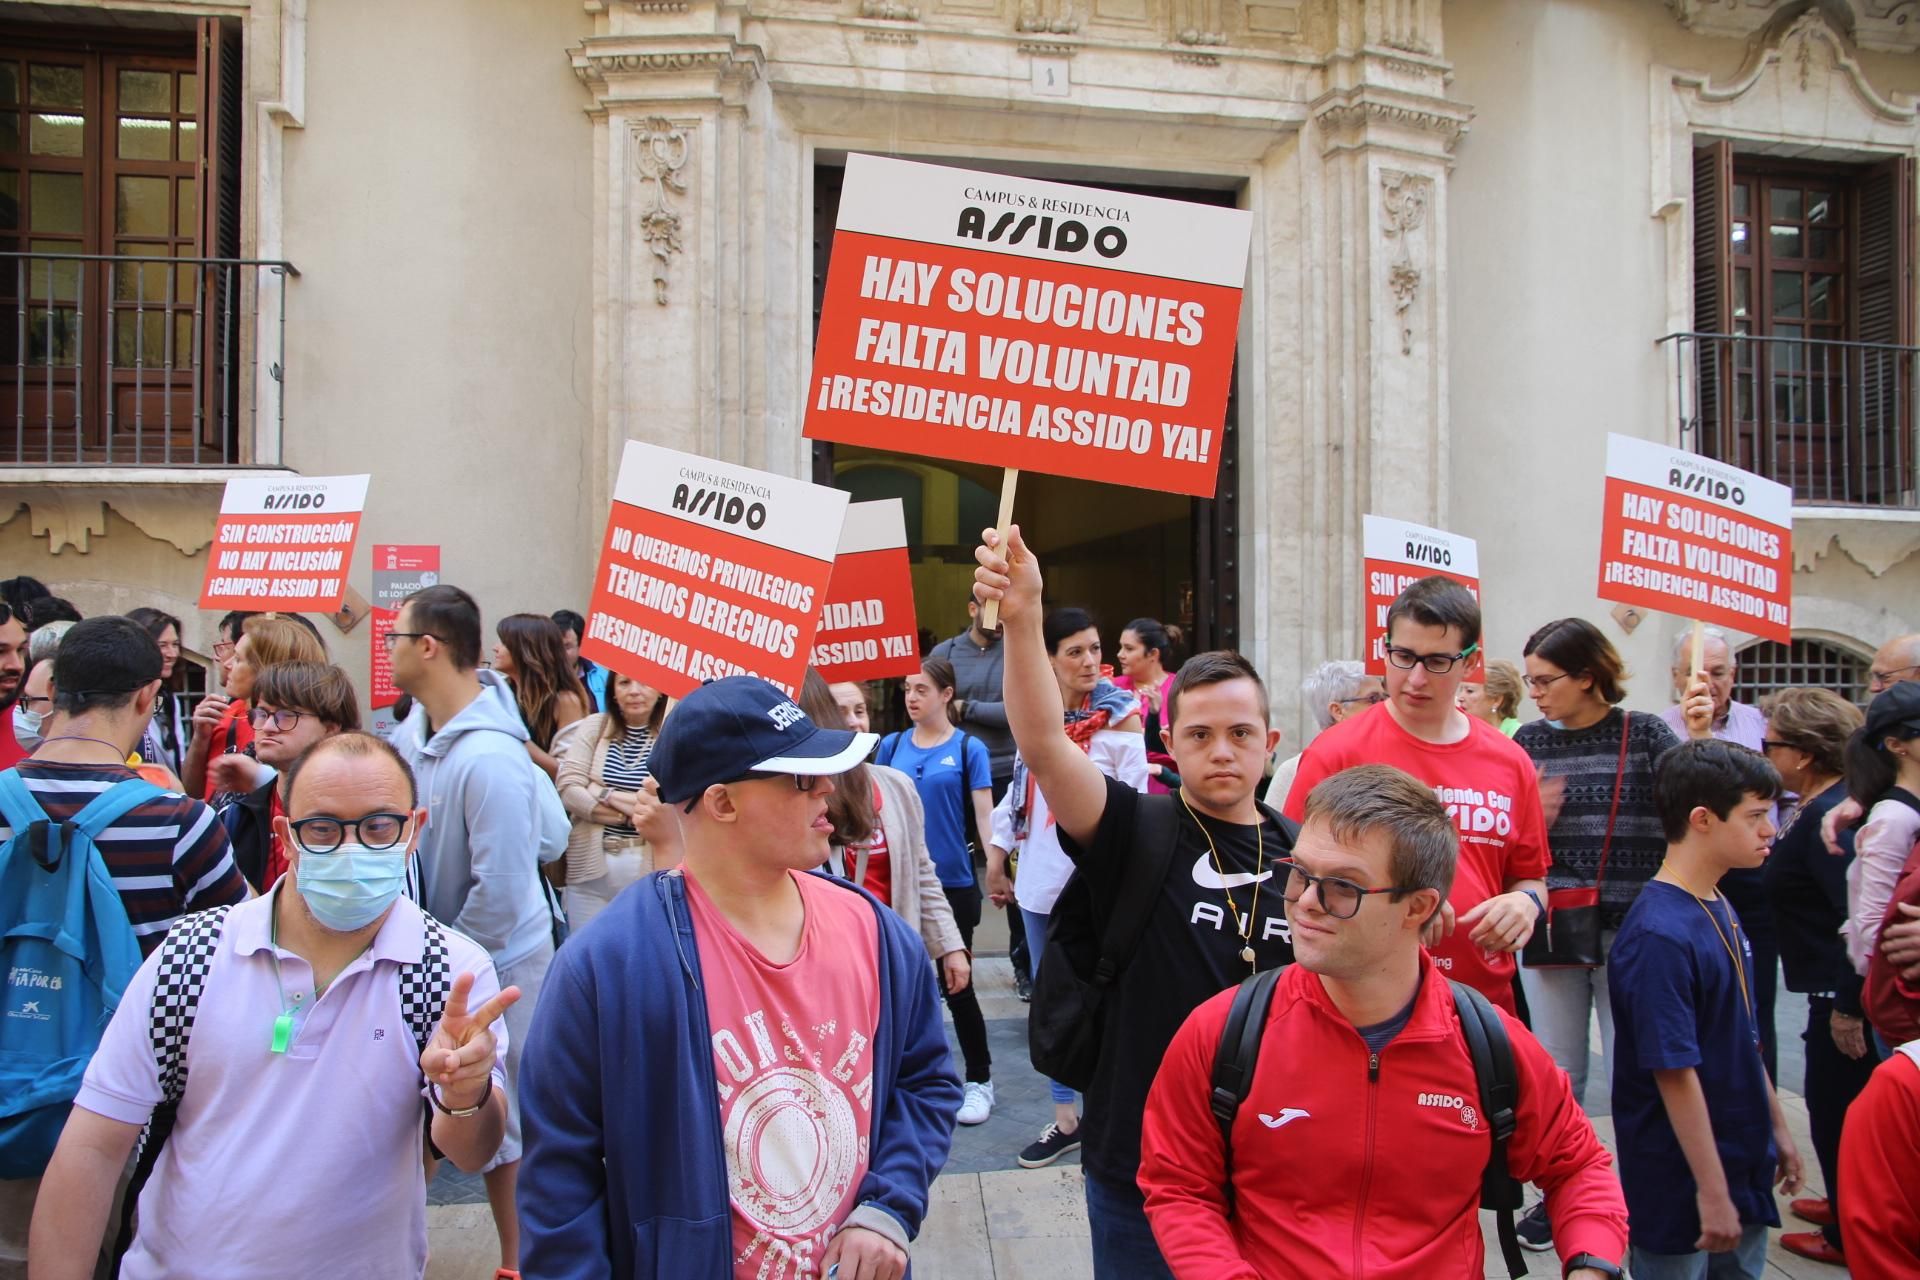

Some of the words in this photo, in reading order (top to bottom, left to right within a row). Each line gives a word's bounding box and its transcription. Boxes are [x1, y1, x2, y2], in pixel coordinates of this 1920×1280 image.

[964, 187, 1026, 207] CAMPUS
[1028, 196, 1038, 209] &
[1042, 198, 1130, 222] RESIDENCIA
[957, 206, 1127, 258] ASSIDO
[860, 255, 943, 307] HAY
[947, 267, 1205, 346] SOLUCIONES
[854, 318, 966, 376] FALTA
[978, 335, 1191, 408] VOLUNTAD
[816, 374, 1021, 436] ¡RESIDENCIA
[1027, 404, 1152, 455] ASSIDO
[1161, 423, 1212, 464] YA!
[264, 493, 325, 509] ASSIDO
[680, 467, 712, 484] CAMPUS
[713, 476, 719, 486] &
[721, 477, 771, 500] RESIDENCIA
[1669, 469, 1745, 505] ASSIDO
[672, 483, 767, 531] ASSIDO
[220, 524, 245, 543] SIN
[246, 520, 354, 543] CONSTRUCCIÓN
[1622, 492, 1664, 525] HAY
[1666, 503, 1780, 560] SOLUCIONES
[218, 551, 240, 570] NO
[240, 551, 269, 570] HAY
[268, 548, 343, 571] INCLUSIÓN
[611, 526, 631, 551] NO
[632, 532, 711, 579] QUEREMOS
[711, 558, 815, 613] PRIVILEGIOS
[1406, 541, 1451, 567] ASSIDO
[1622, 528, 1680, 566] FALTA
[1684, 543, 1777, 594] VOLUNTAD
[208, 577, 269, 597] ¡CAMPUS
[269, 578, 319, 597] ASSIDO
[320, 578, 340, 597] YA!
[379, 590, 388, 598] DE
[391, 582, 421, 590] PALACIO
[1371, 571, 1395, 596] SIN
[1604, 561, 1708, 602] ¡RESIDENCIA
[1710, 585, 1765, 618] ASSIDO
[1767, 600, 1788, 626] YA!
[607, 563, 689, 619] TENEMOS
[688, 592, 798, 659] DERECHOS
[588, 612, 688, 674] ¡RESIDENCIA
[808, 639, 877, 667] ASSIDO
[881, 635, 913, 658] YA!
[1487, 790, 1512, 812] Con
[1190, 901, 1291, 944] AIR
[1418, 1093, 1464, 1109] ASSIDO
